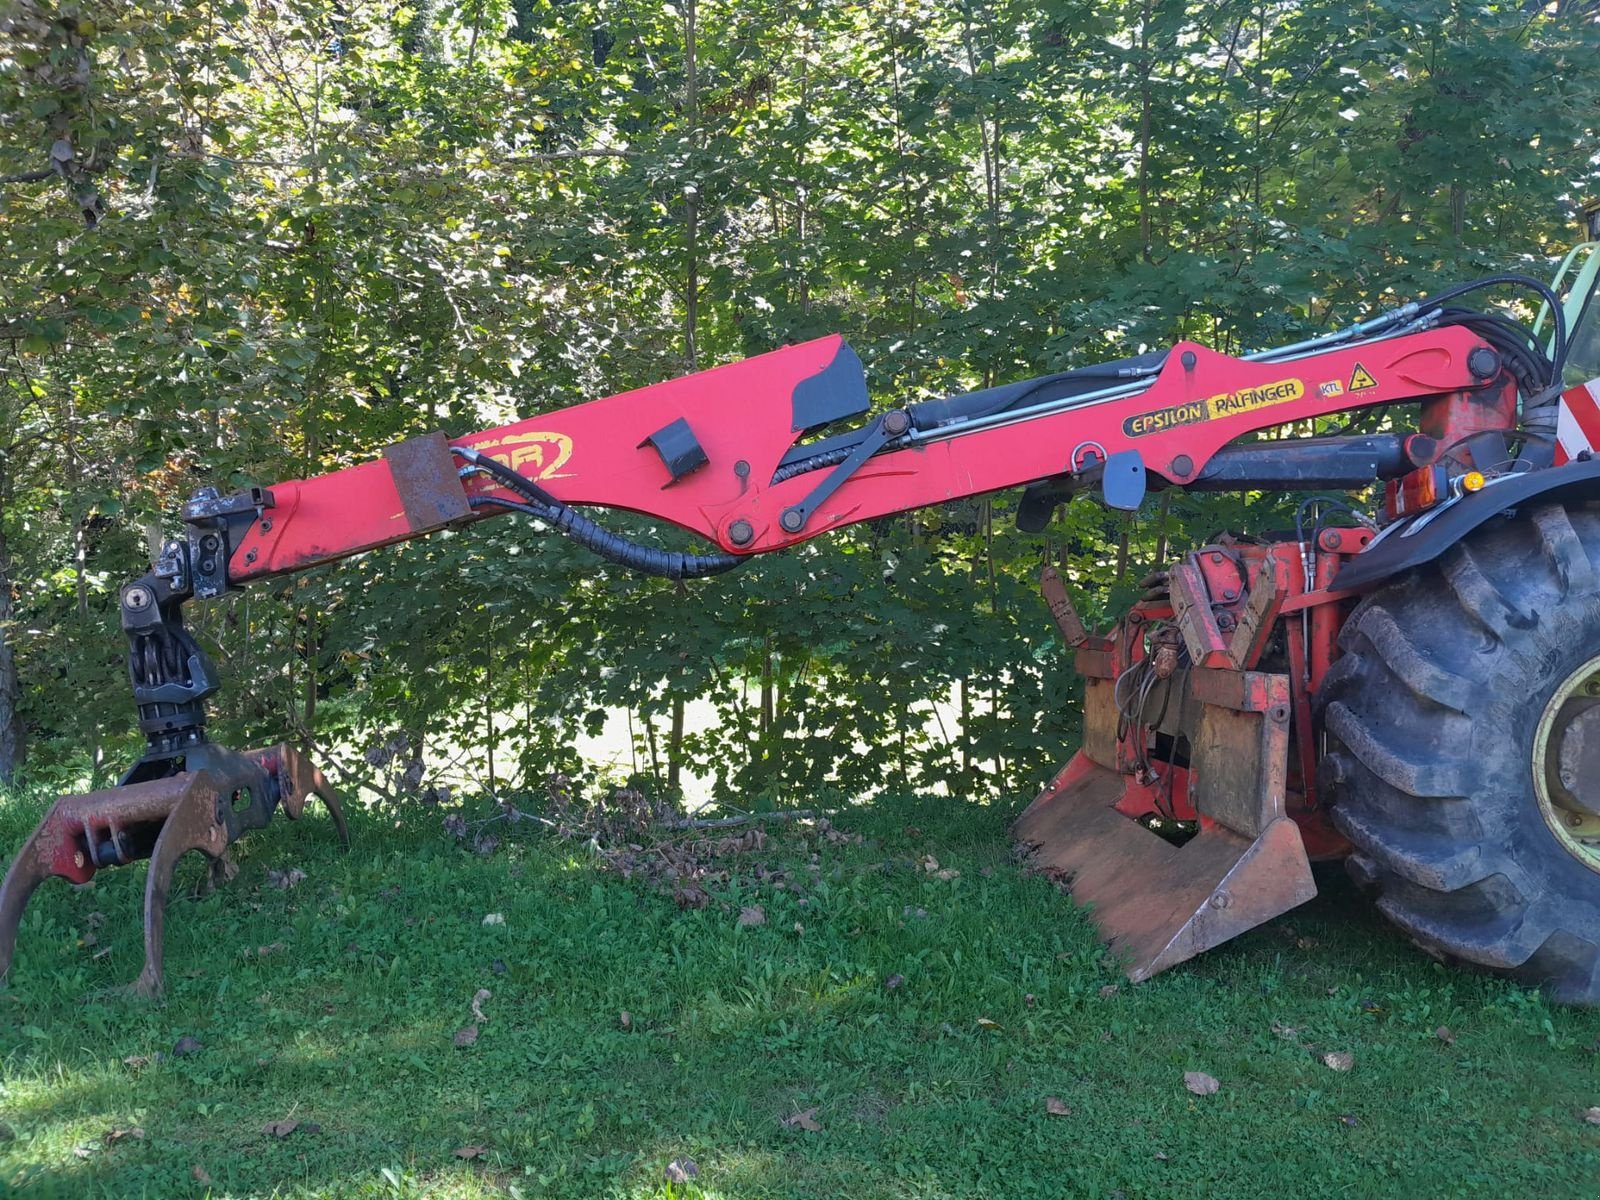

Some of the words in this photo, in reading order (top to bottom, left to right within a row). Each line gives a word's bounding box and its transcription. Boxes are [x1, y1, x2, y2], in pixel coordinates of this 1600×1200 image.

[1321, 382, 1341, 394] KTL
[1131, 404, 1201, 433] EPSILON
[1215, 382, 1297, 413] PALFINGER
